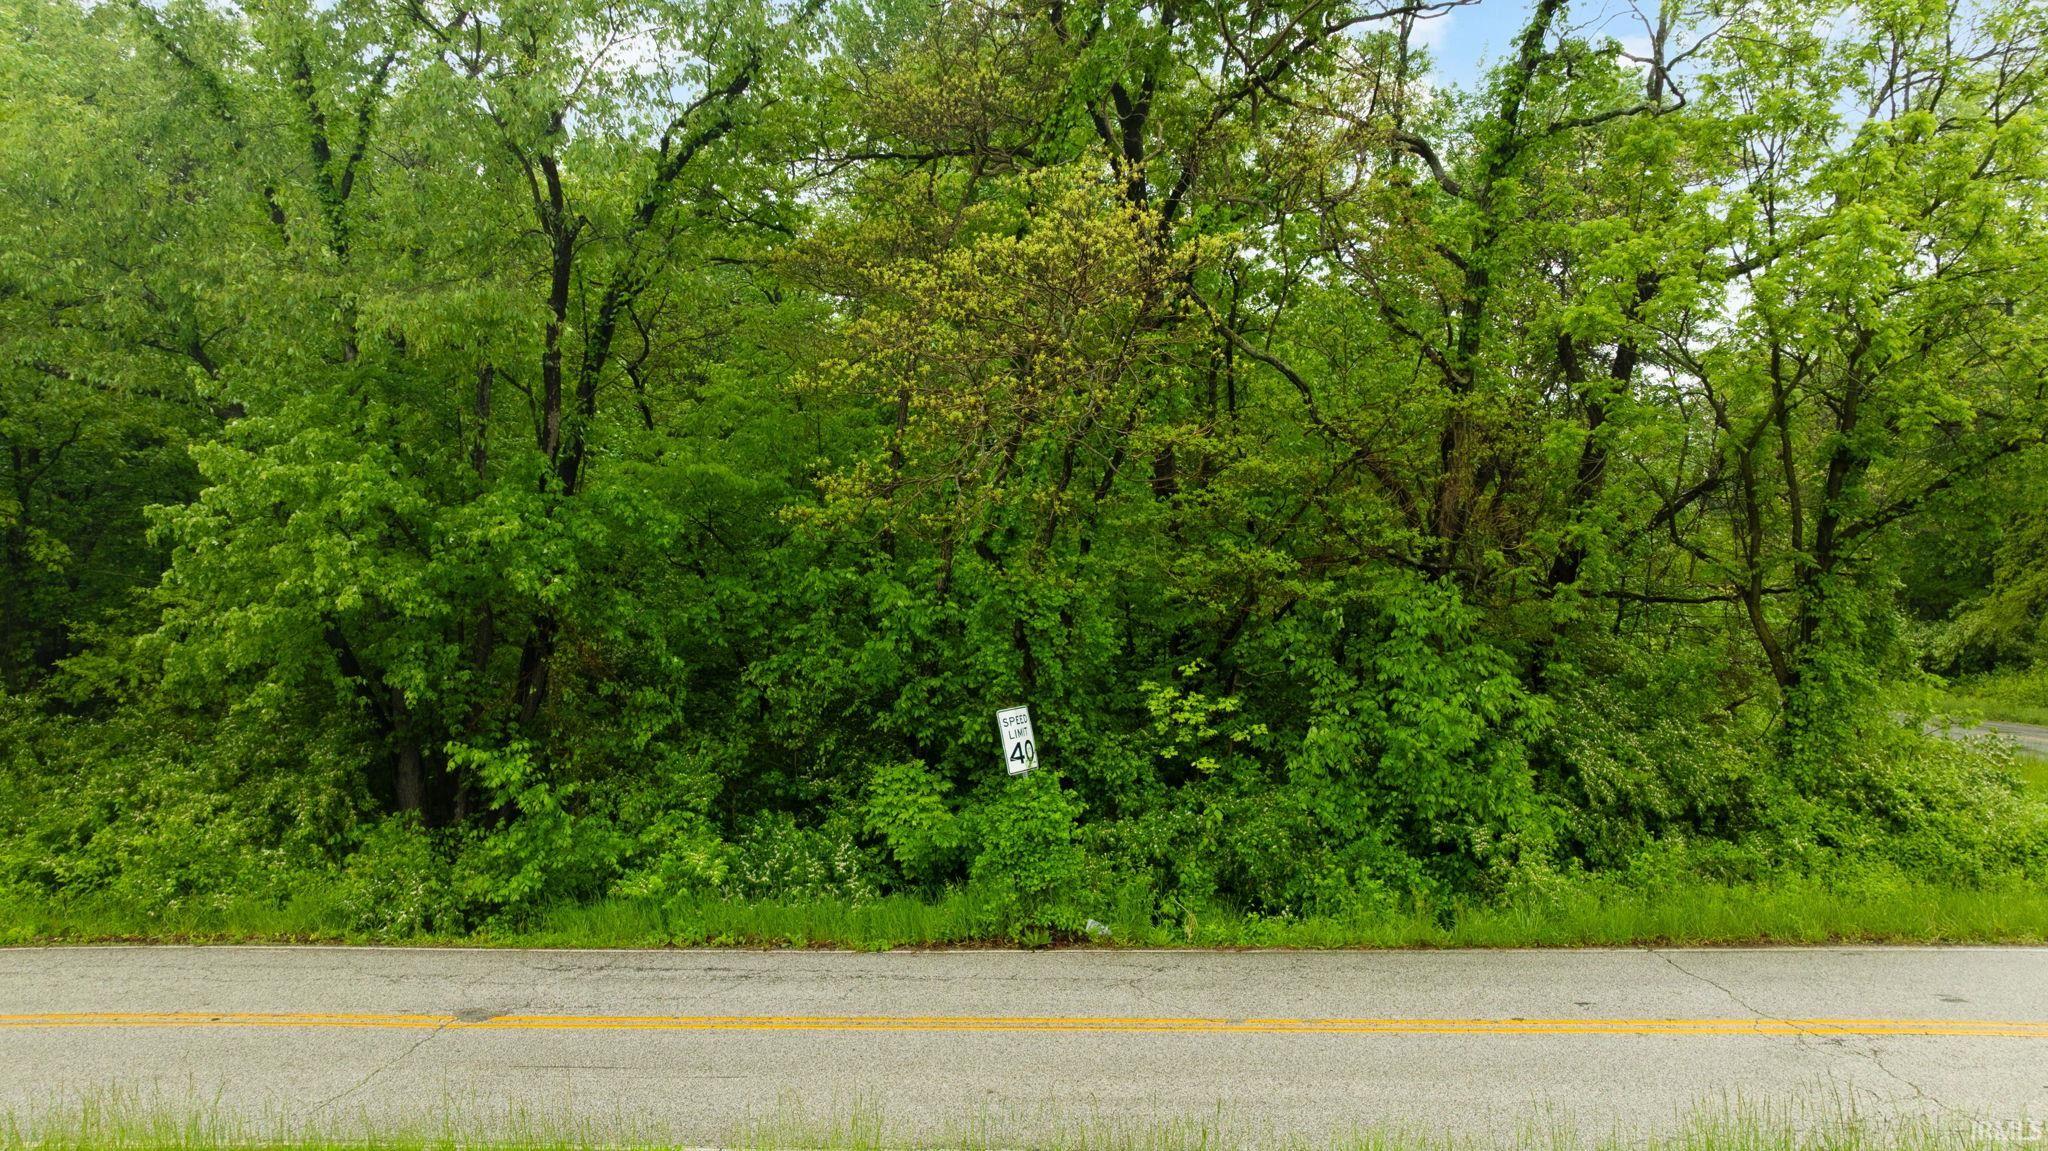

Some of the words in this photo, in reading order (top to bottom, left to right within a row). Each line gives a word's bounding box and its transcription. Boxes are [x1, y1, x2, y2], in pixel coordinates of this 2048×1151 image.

[1002, 714, 1028, 727] SPEED
[1008, 727, 1028, 739] LIMIT
[1010, 739, 1034, 764] 40
